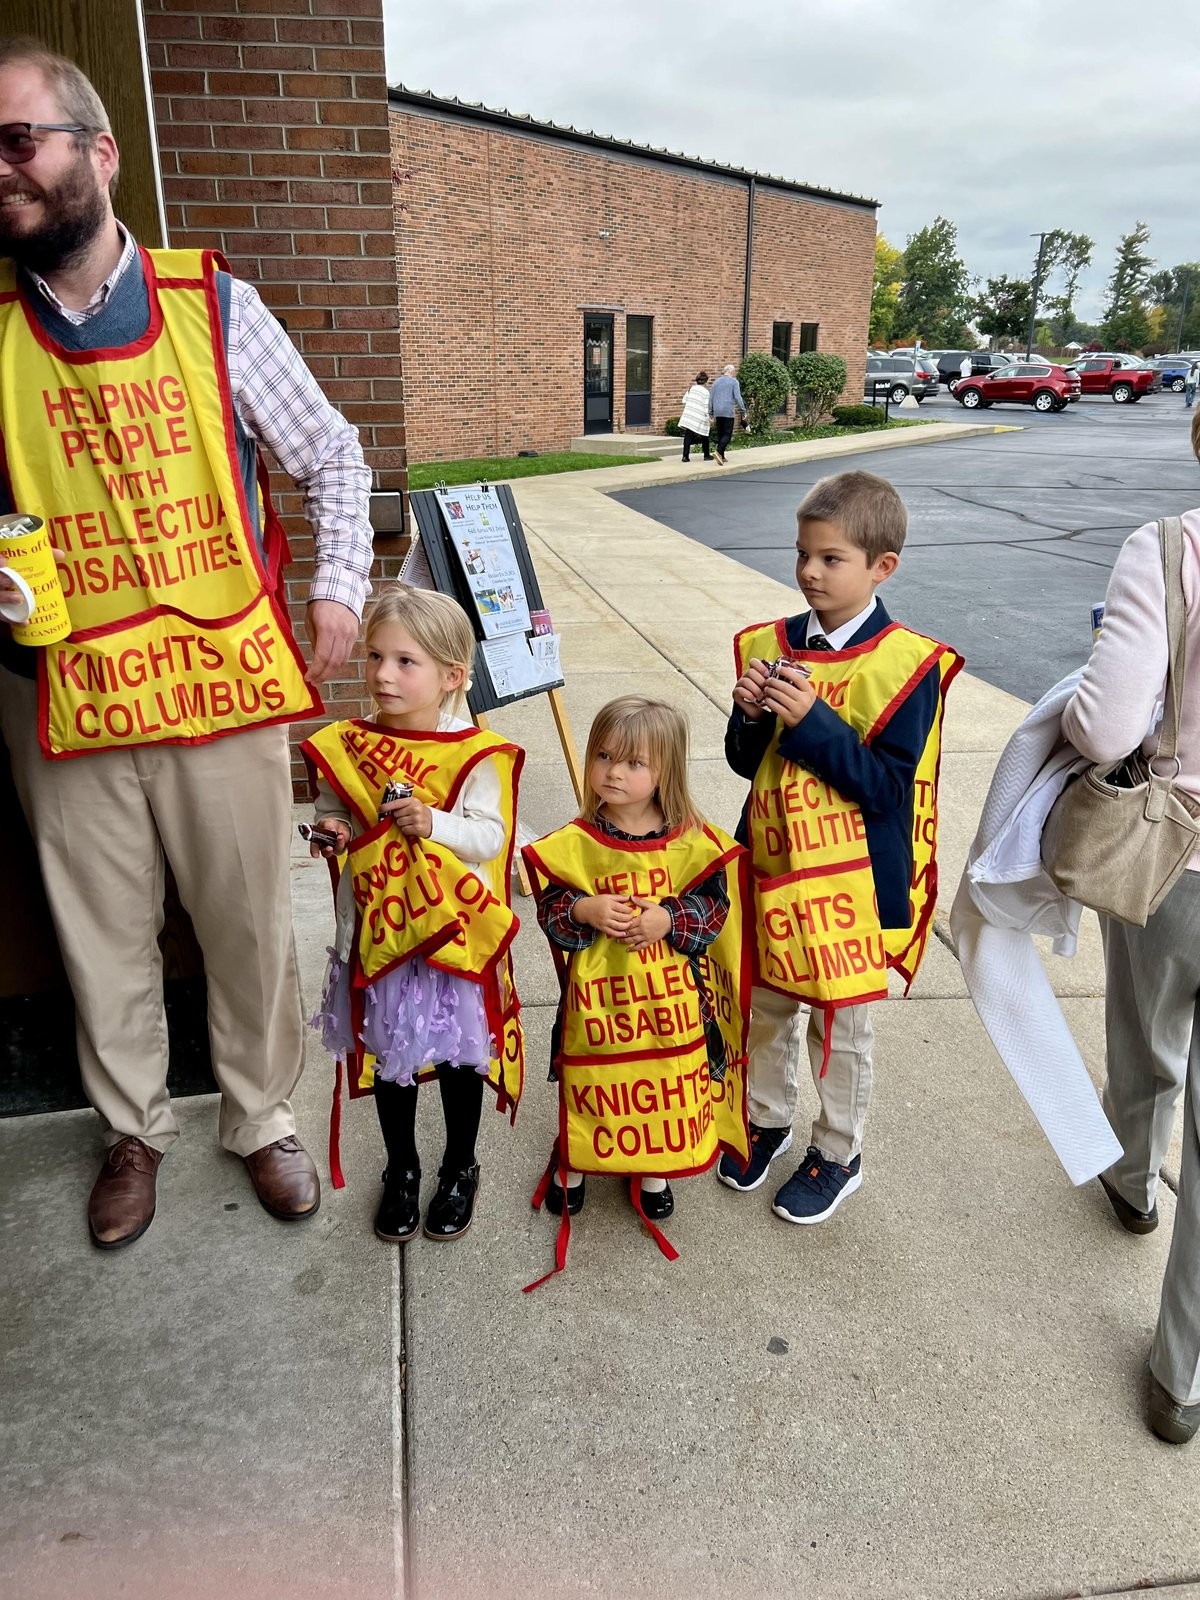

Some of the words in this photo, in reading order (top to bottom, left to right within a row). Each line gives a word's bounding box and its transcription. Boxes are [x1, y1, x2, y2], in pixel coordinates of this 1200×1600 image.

[42, 375, 186, 427] HELPING
[60, 417, 192, 468] PEOPLE
[104, 468, 168, 501] WITH
[48, 494, 226, 552] NTELLECTUA
[0, 547, 28, 561] ghts
[31, 541, 42, 554] of
[57, 532, 242, 598] DISABILITIES
[29, 612, 59, 625] LITIES
[58, 635, 224, 694] KNIGHTS
[239, 624, 275, 675] OF
[75, 678, 285, 739] COLUMBUS
[764, 892, 856, 941] GHTS
[765, 933, 886, 983] OLUMBU
[570, 960, 698, 1013] INTELLEC
[571, 1061, 709, 1117] KNIGHTS
[592, 1100, 711, 1159] COLUMB
